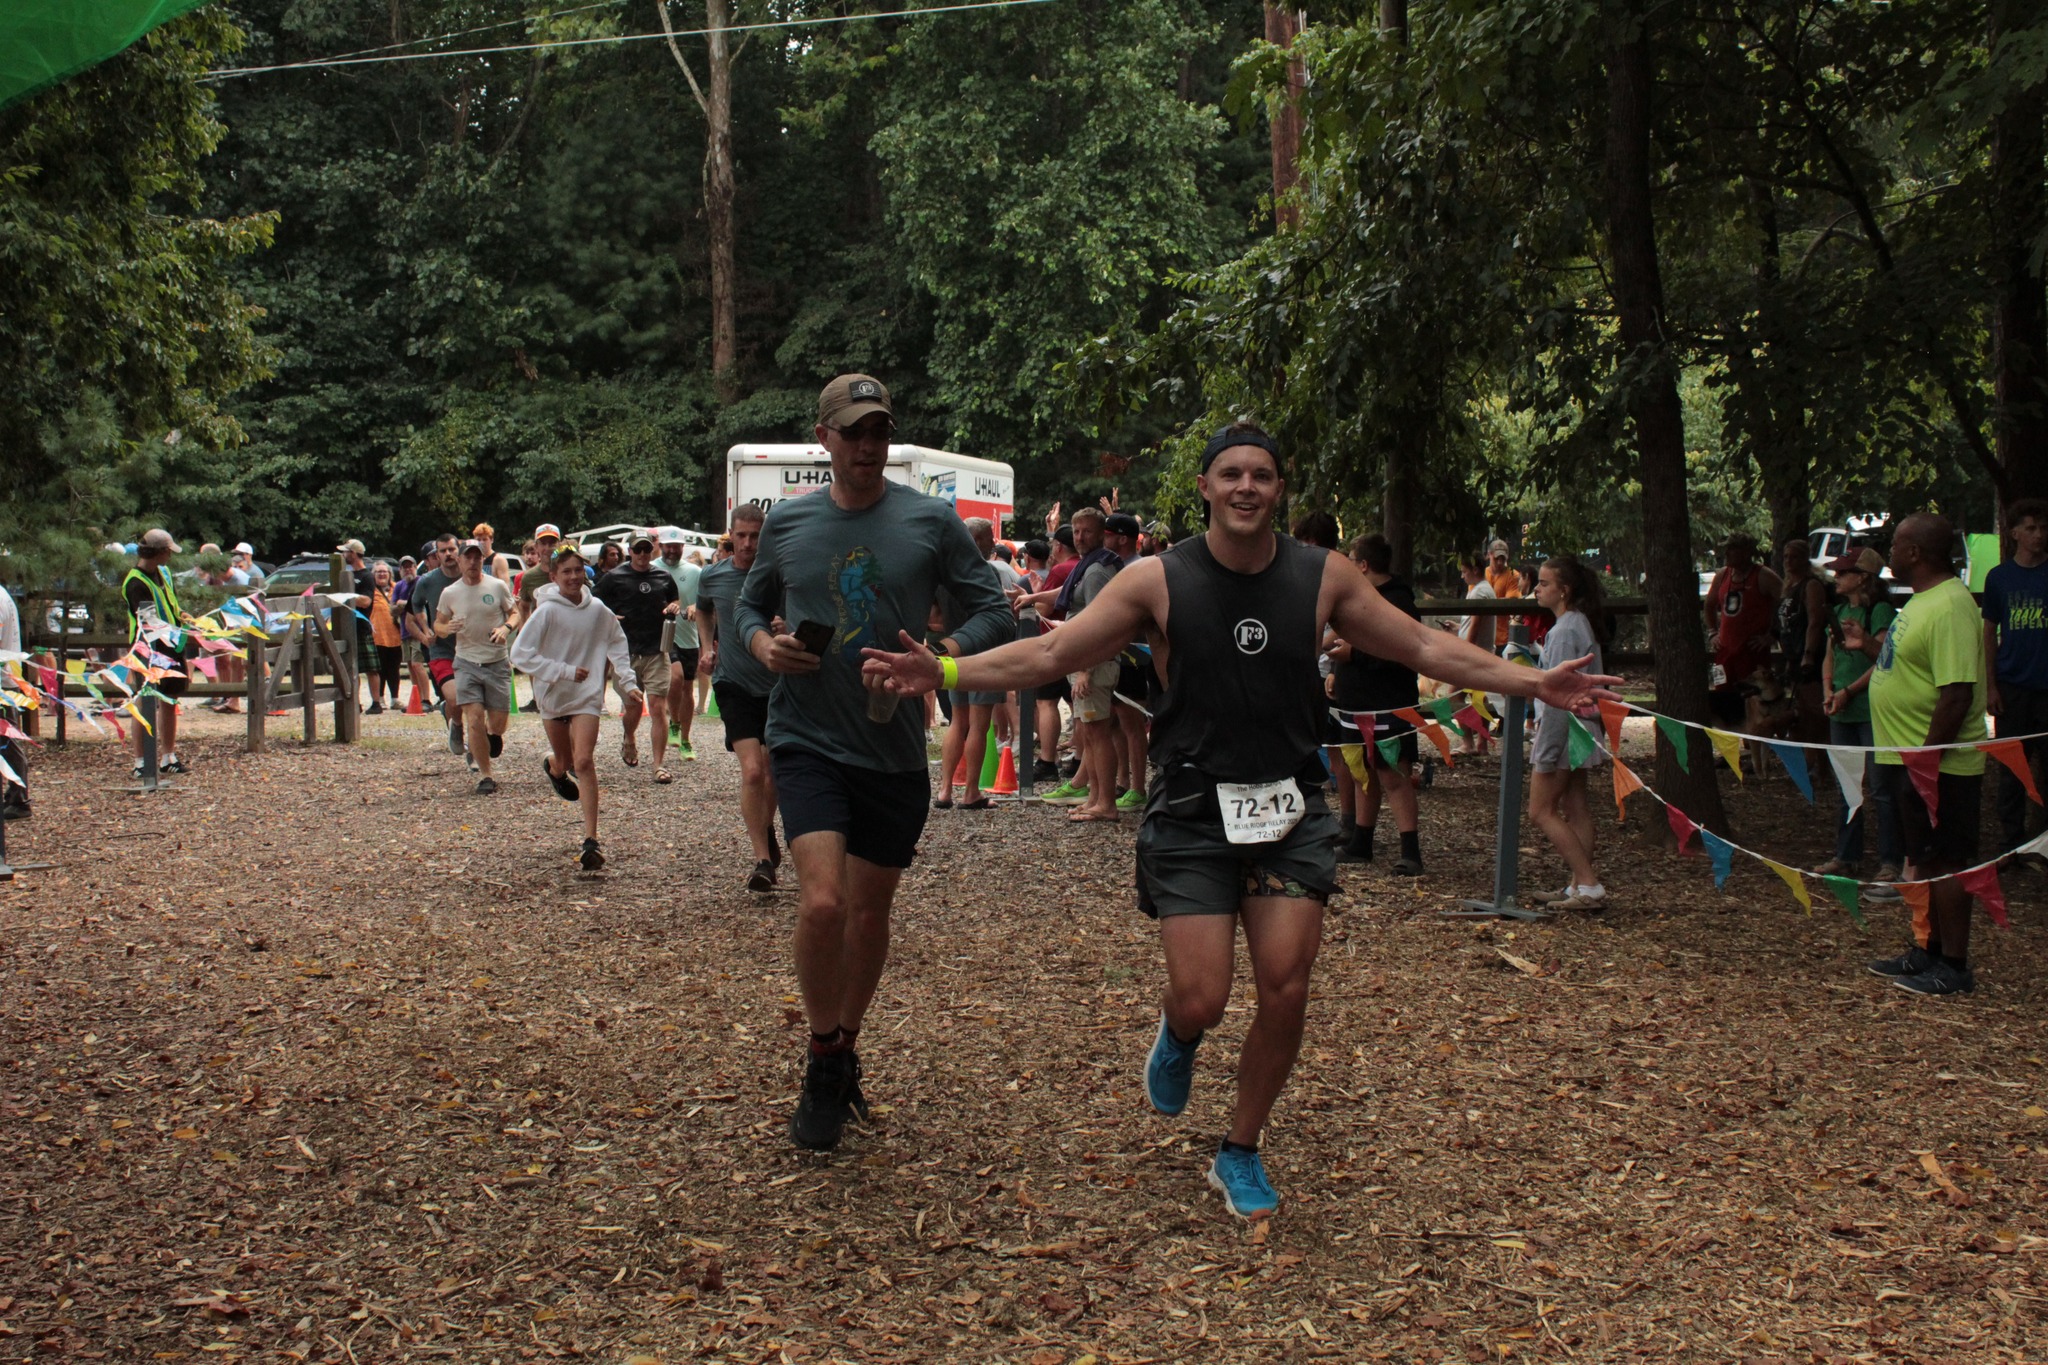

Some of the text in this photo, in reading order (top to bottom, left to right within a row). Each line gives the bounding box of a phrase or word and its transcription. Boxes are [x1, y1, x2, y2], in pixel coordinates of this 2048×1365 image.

[974, 476, 1001, 498] U-HAUL
[1240, 626, 1263, 646] F3
[1230, 793, 1297, 818] 72-12
[1234, 822, 1249, 830] BLUE
[1250, 821, 1267, 829] RIDGE
[1268, 819, 1286, 827] RELAY
[1256, 829, 1281, 838] 72-12
